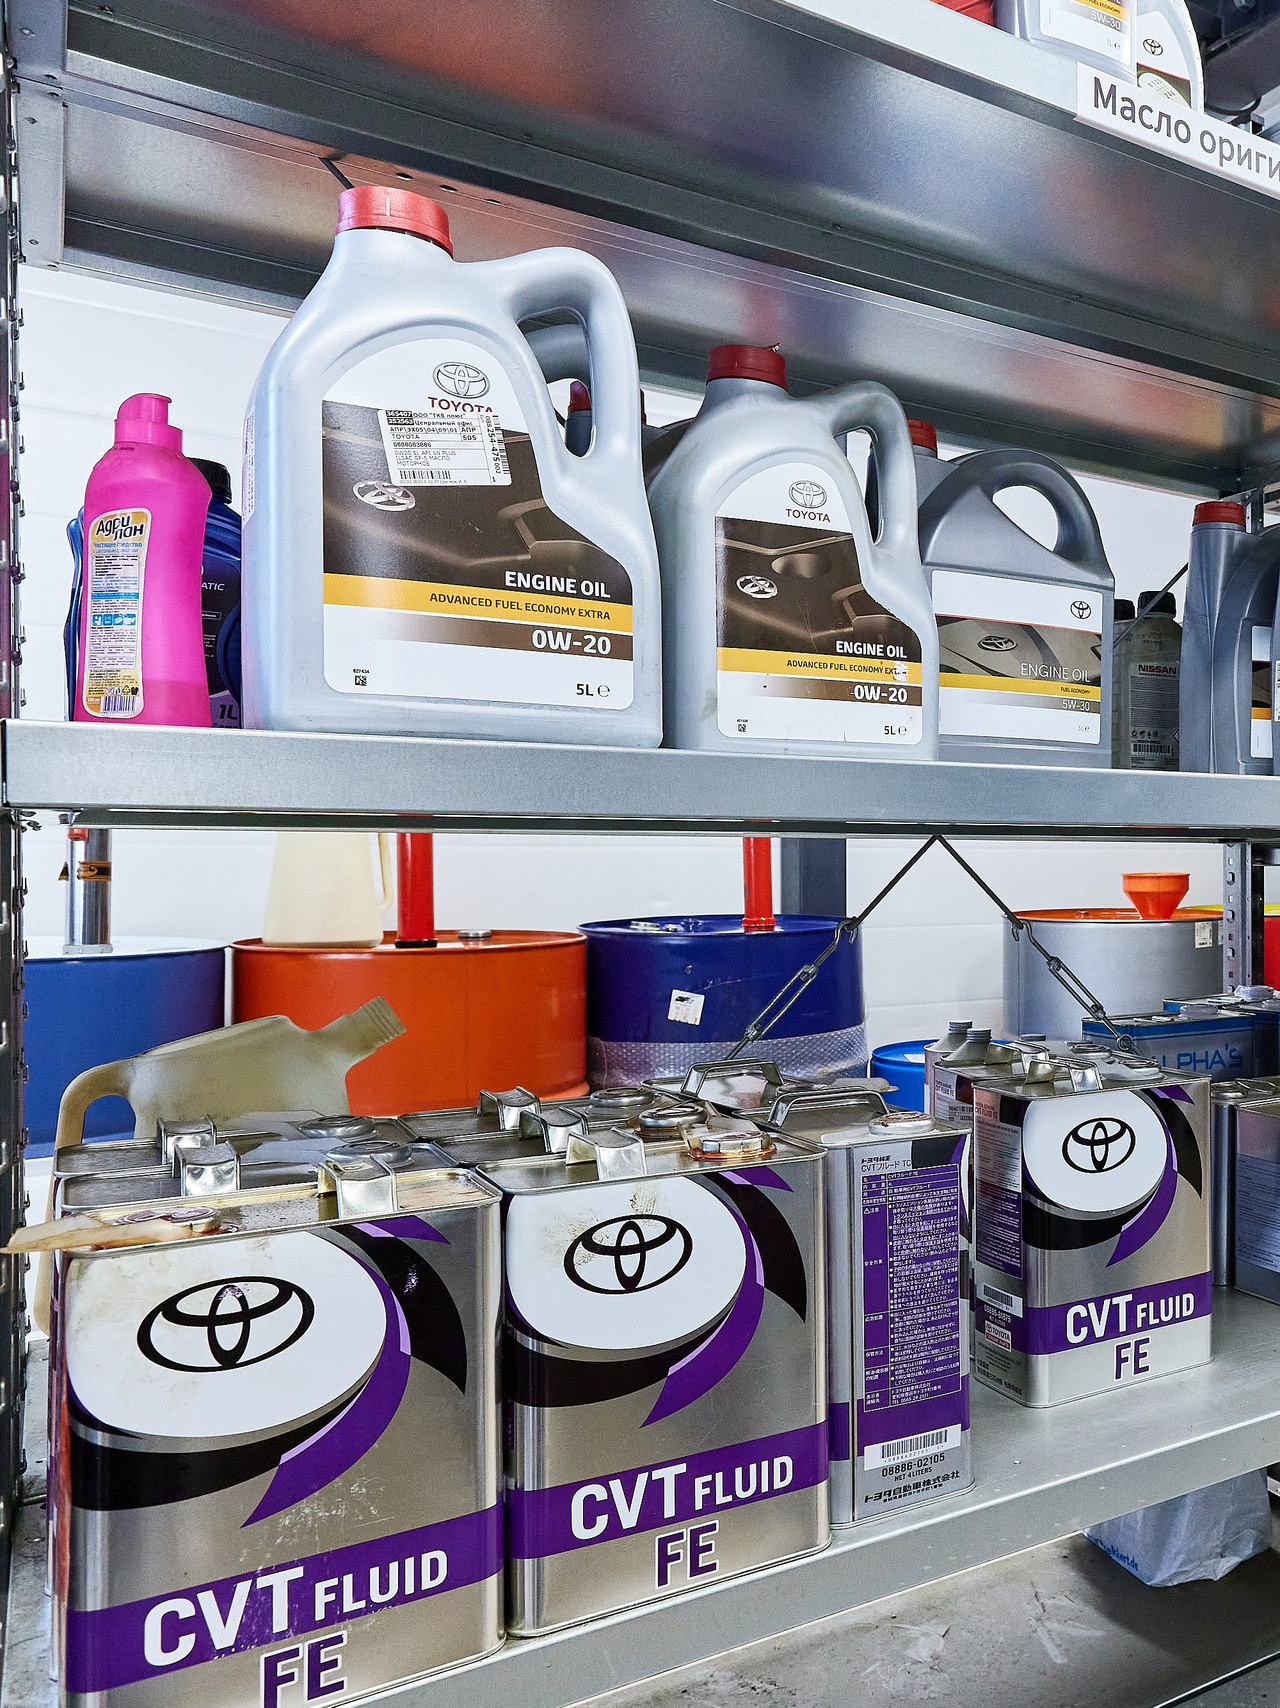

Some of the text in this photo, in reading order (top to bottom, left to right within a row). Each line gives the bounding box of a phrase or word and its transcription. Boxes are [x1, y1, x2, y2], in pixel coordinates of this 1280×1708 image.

[1091, 10, 1121, 30] 5W-30
[1093, 76, 1191, 144] Масло
[427, 396, 493, 413] TOYOTA
[785, 508, 831, 523] TOYOTA
[505, 570, 611, 599] ENGINE OIL
[429, 592, 611, 620] ADVANCED FUEL ECONOMY EXTRA
[531, 629, 612, 655] 0W-20
[835, 640, 908, 659] ENGINE OIL
[786, 659, 884, 674] ADVANCED FUEL ECONOMY
[1021, 662, 1091, 683] ENGINE OIL
[1138, 664, 1177, 675] NISSAN
[575, 683, 594, 697] 5L
[853, 684, 908, 703] 0W-20
[1070, 687, 1091, 695] ECONOMY
[219, 703, 238, 720] 1L
[1062, 700, 1091, 712] 5W-30
[884, 725, 897, 736] 5L
[861, 1159, 912, 1173] CVTフルード TC
[1066, 1292, 1195, 1344] CVT FLUID
[1113, 1335, 1152, 1382] FE
[881, 1453, 945, 1477] 08886-02105
[864, 1470, 960, 1503] トヨタ自動車株式会社
[894, 1472, 906, 1482] NET
[570, 1455, 794, 1541] CVT FLUID
[654, 1520, 720, 1590] FE
[144, 1549, 449, 1667] CVT FLUID
[259, 1629, 348, 1708] FE
